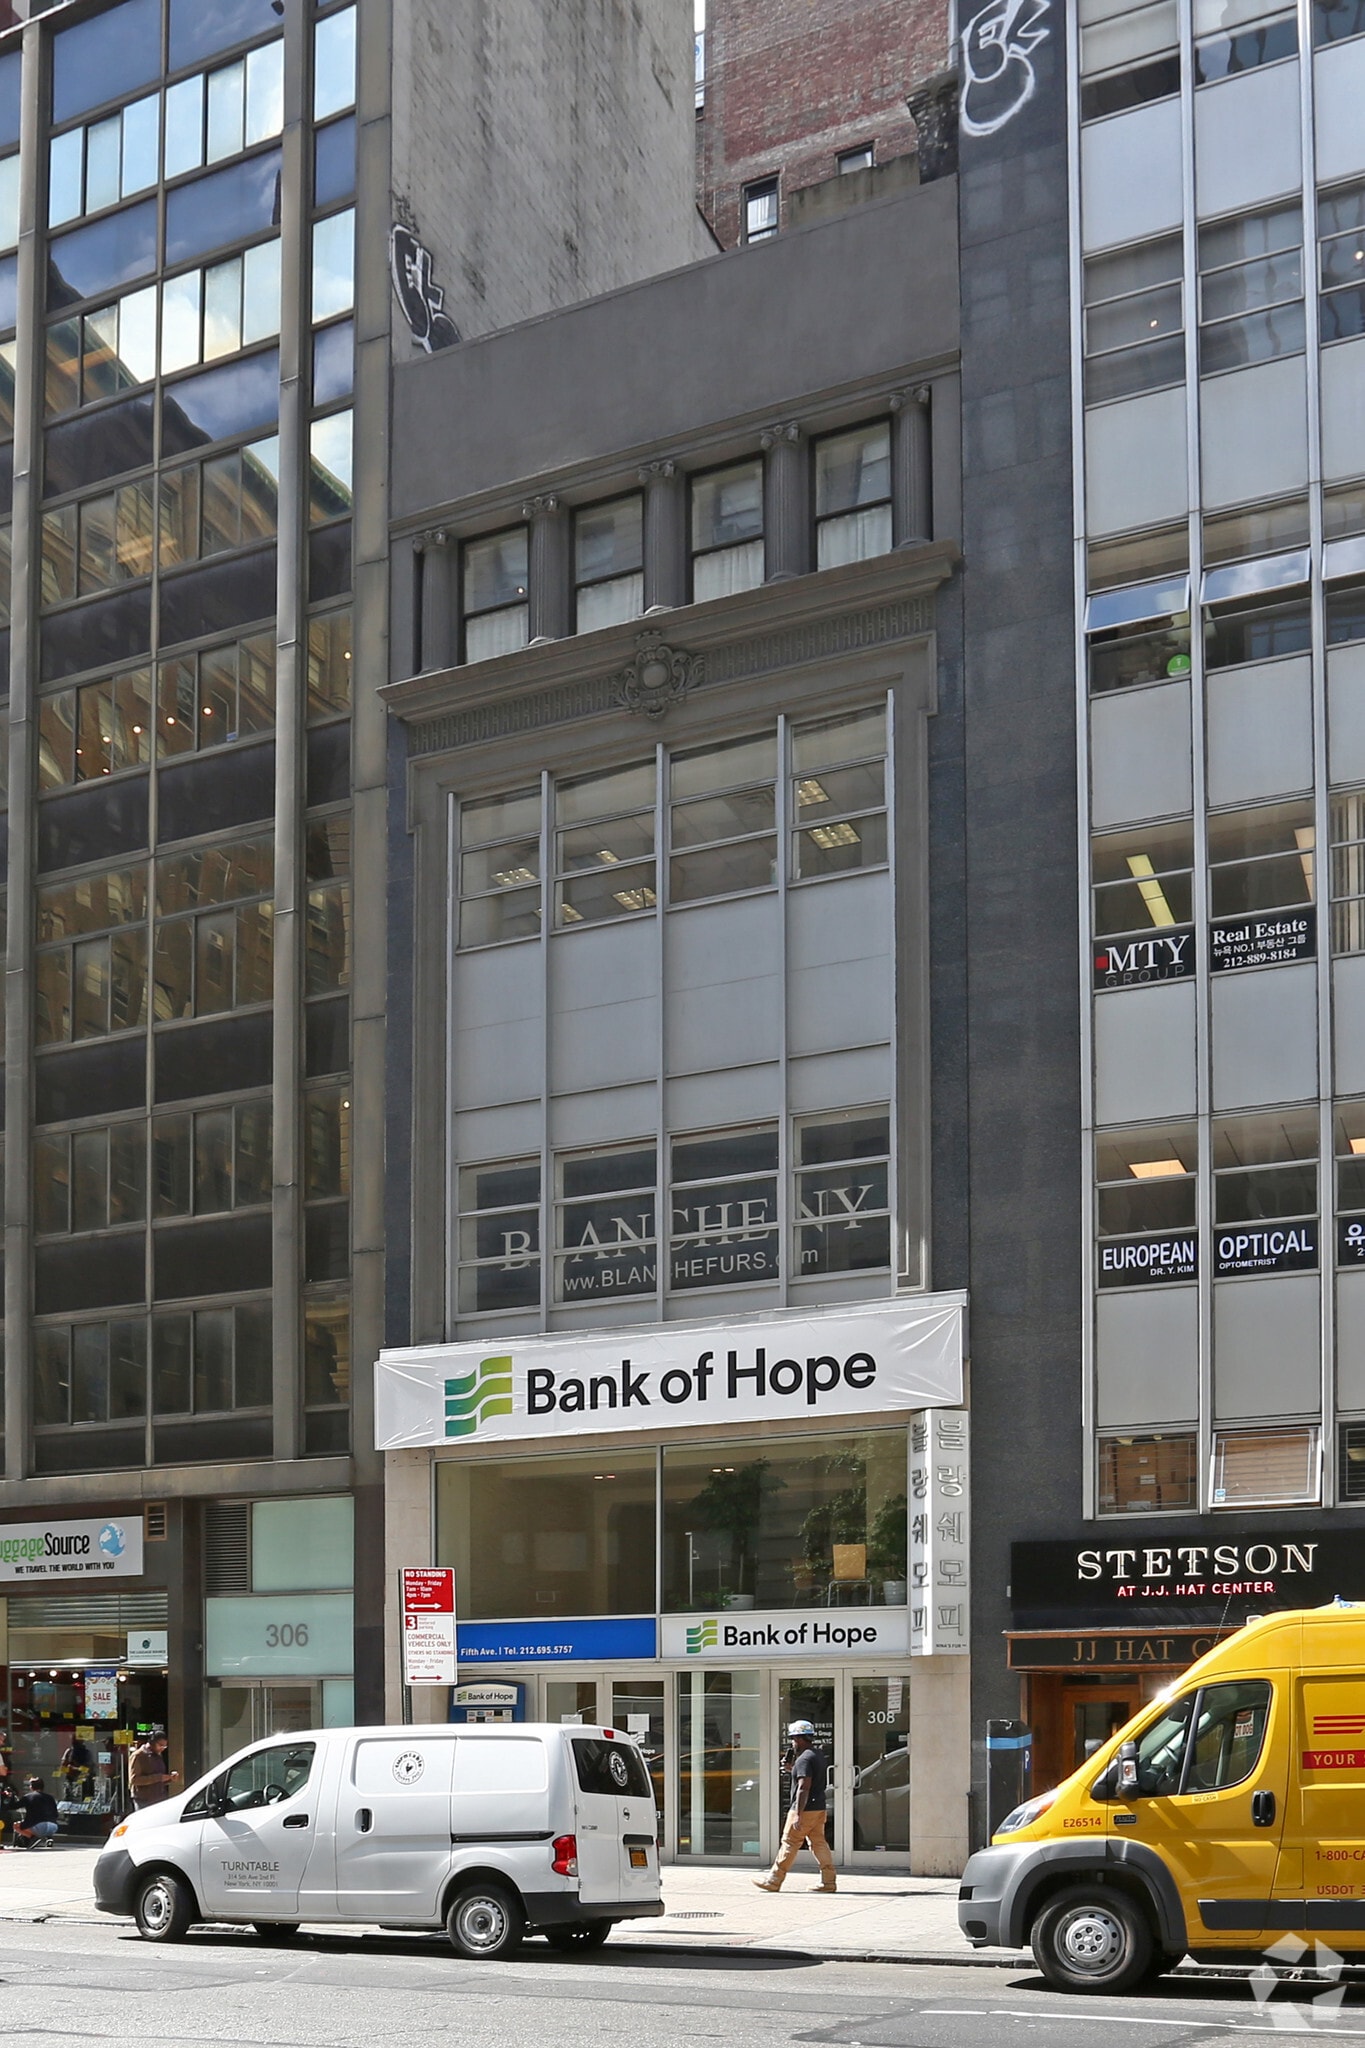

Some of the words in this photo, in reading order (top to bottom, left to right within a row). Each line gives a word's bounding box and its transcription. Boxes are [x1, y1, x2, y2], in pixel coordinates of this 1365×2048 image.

[1212, 926, 1250, 945] Real
[1255, 919, 1308, 939] Estate
[1213, 945, 1232, 957] 뉴욕
[1233, 943, 1255, 953] NO.1
[1257, 937, 1285, 950] 부동산
[1287, 933, 1307, 945] 그룹
[1105, 934, 1190, 974] MTY
[1223, 948, 1297, 968] 212-889-8184
[1105, 964, 1185, 988] GROUP
[500, 1197, 769, 1271] BANCHE
[799, 1184, 875, 1232] NY
[1102, 1240, 1195, 1271] EUROPEAN
[1219, 1229, 1314, 1260] OPTICAL
[1150, 1267, 1166, 1276] DR.
[1167, 1266, 1176, 1275] Y.
[1177, 1264, 1195, 1274] KIM
[1219, 1257, 1277, 1270] OPTOMETRIST
[527, 1360, 652, 1415] Bank
[660, 1351, 714, 1404] of
[727, 1347, 877, 1405] Hope
[15, 1566, 24, 1574] WE
[25, 1565, 48, 1573] TRAVEL
[49, 1564, 61, 1572] THE
[61, 1563, 84, 1571] WORLD
[85, 1562, 101, 1570] WITH
[103, 1561, 115, 1570] YOU
[1076, 1543, 1319, 1580] STETSON
[415, 1570, 447, 1578] STANDING
[1117, 1585, 1137, 1597] AT
[1141, 1584, 1169, 1597] J.J.
[1176, 1583, 1206, 1596] HAT
[1211, 1581, 1275, 1595] CENTER
[407, 1616, 416, 1630] 3
[266, 1623, 309, 1648] 306
[724, 1624, 780, 1646] Bank
[784, 1623, 808, 1645] of
[813, 1622, 877, 1648] Hope
[460, 1648, 479, 1656] Fifth
[480, 1647, 498, 1656] Ave.
[504, 1646, 518, 1655] Tel.
[520, 1645, 573, 1655] 212.695.5757
[1073, 1640, 1097, 1661] JJ
[1115, 1639, 1174, 1661] HAT
[92, 1692, 111, 1701] SALE
[486, 1692, 493, 1700] of
[494, 1692, 513, 1701] Hope
[867, 1711, 895, 1724] 308
[1313, 1753, 1356, 1766] YOUR
[1063, 1817, 1102, 1828] E26514
[220, 1861, 280, 1871] TURNTABLE
[1317, 1885, 1355, 1895] USDOT
